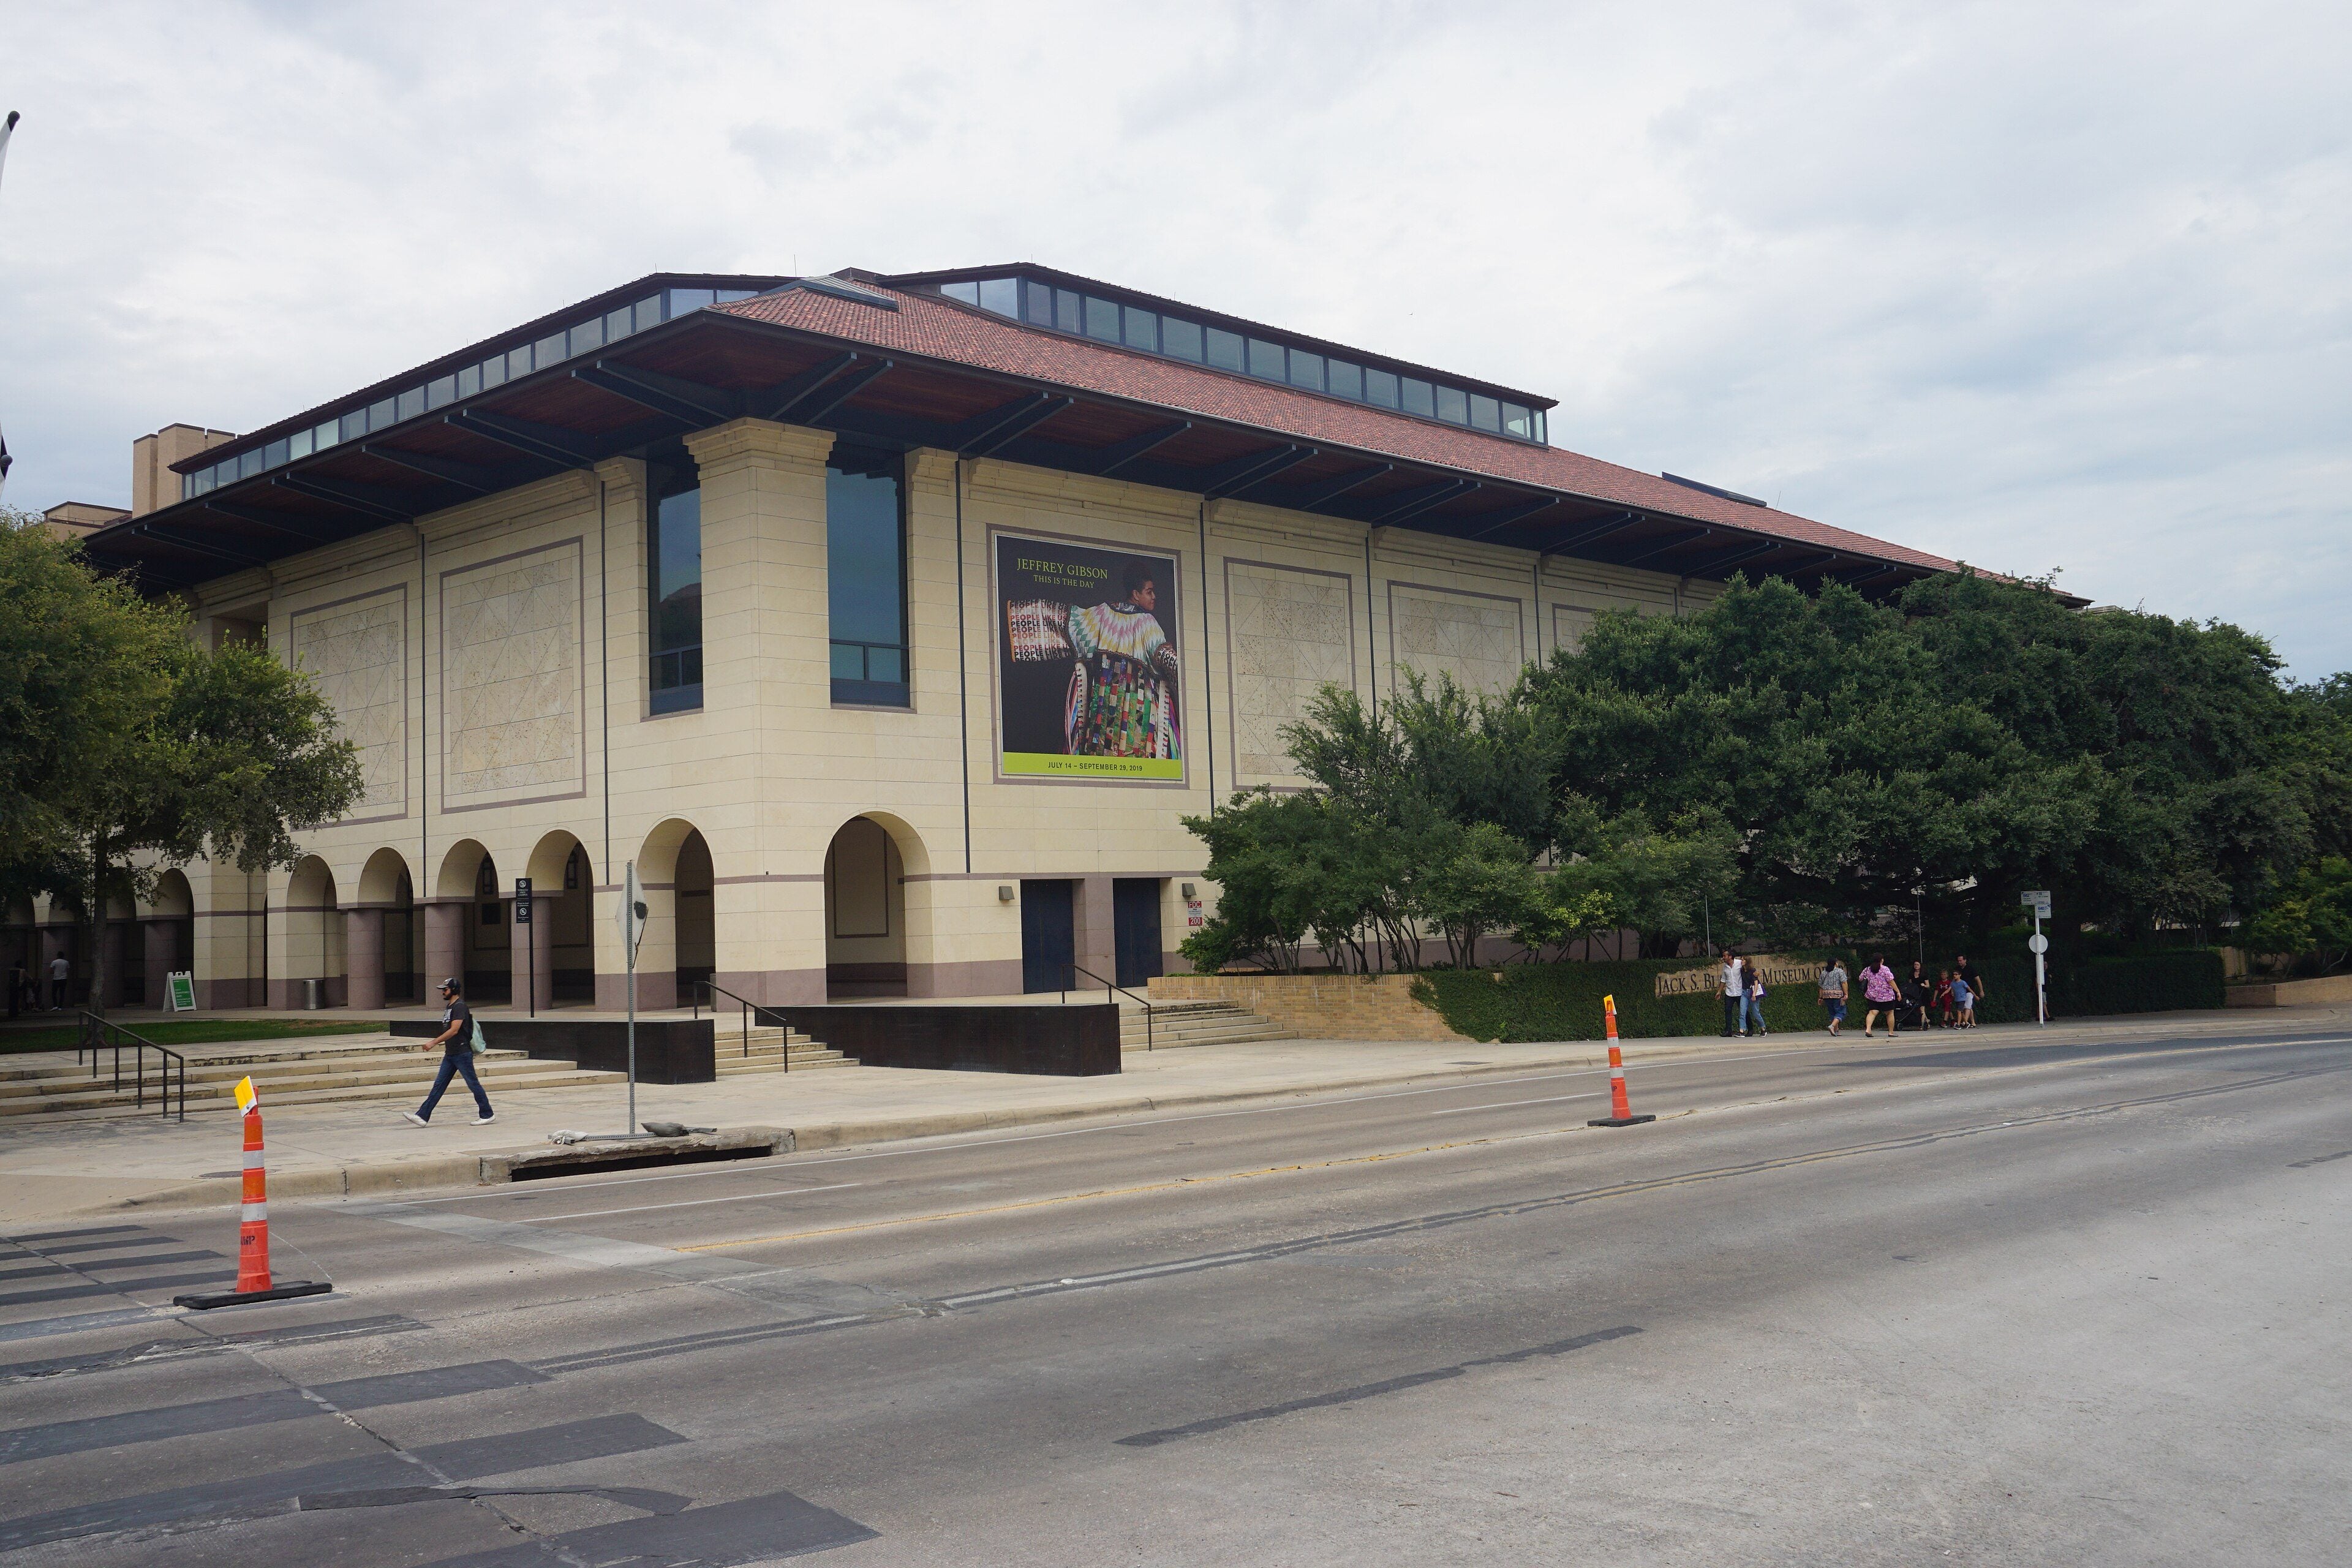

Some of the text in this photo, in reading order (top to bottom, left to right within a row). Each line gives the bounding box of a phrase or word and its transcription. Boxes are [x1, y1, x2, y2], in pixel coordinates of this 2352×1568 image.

[1017, 558, 1107, 579] JEFFREY GIBSON
[1033, 575, 1052, 583] THIS
[1062, 578, 1077, 587] THE
[1657, 976, 1687, 997] JACK
[1691, 973, 1700, 990] S.
[1762, 967, 1811, 984] MUSEUM
